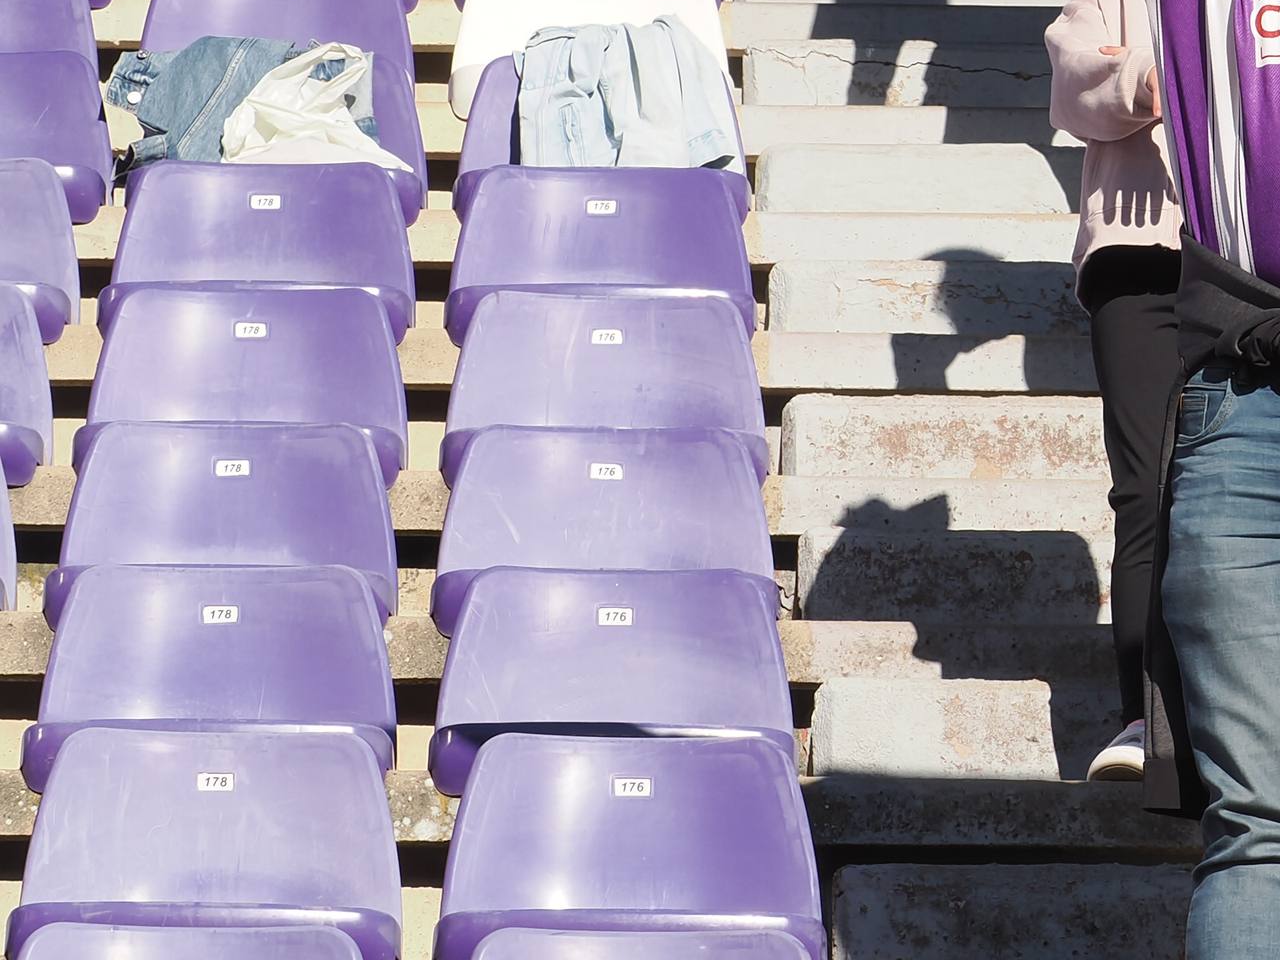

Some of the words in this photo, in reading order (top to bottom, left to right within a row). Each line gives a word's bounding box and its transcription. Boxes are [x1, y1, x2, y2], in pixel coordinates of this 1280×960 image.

[257, 198, 274, 207] 178
[243, 326, 260, 334] 178
[599, 333, 616, 341] 176
[224, 464, 242, 473] 178
[598, 467, 616, 476] 176
[210, 609, 232, 619] 178
[605, 611, 627, 622] 176
[205, 776, 228, 787] 178
[621, 782, 645, 792] 176
